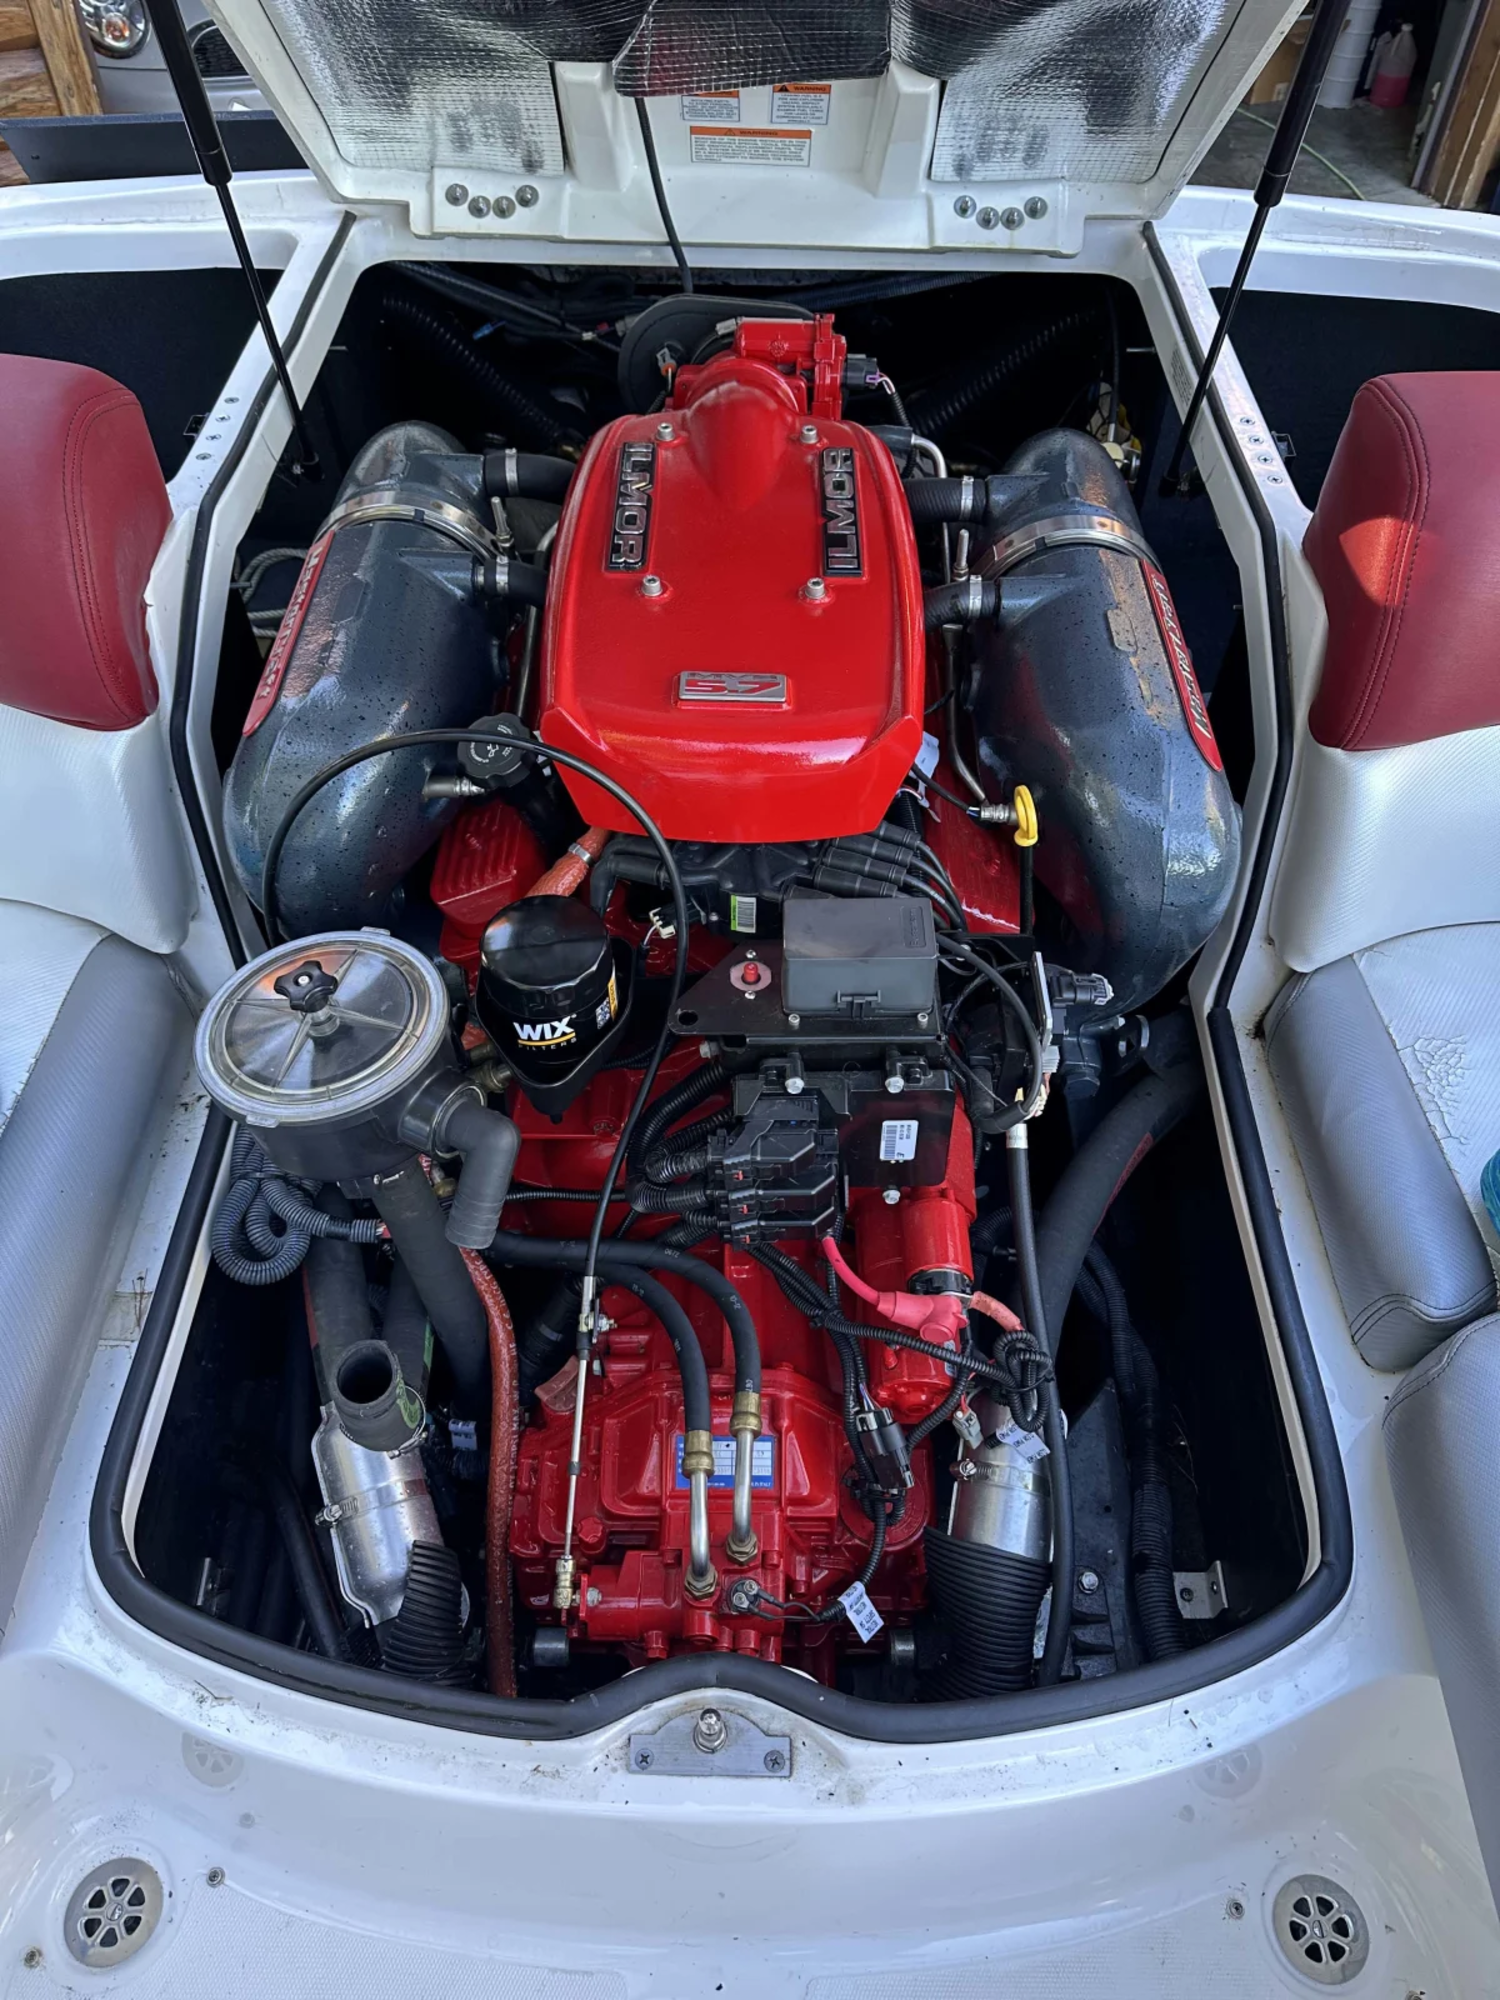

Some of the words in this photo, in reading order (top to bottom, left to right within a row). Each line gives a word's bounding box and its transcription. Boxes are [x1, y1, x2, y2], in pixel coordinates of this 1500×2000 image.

[611, 443, 653, 567] ILMOR
[824, 449, 858, 569] ILMOR
[685, 679, 781, 696] 5.7
[513, 1016, 575, 1040] WIX
[518, 1037, 577, 1051] FILTERS
